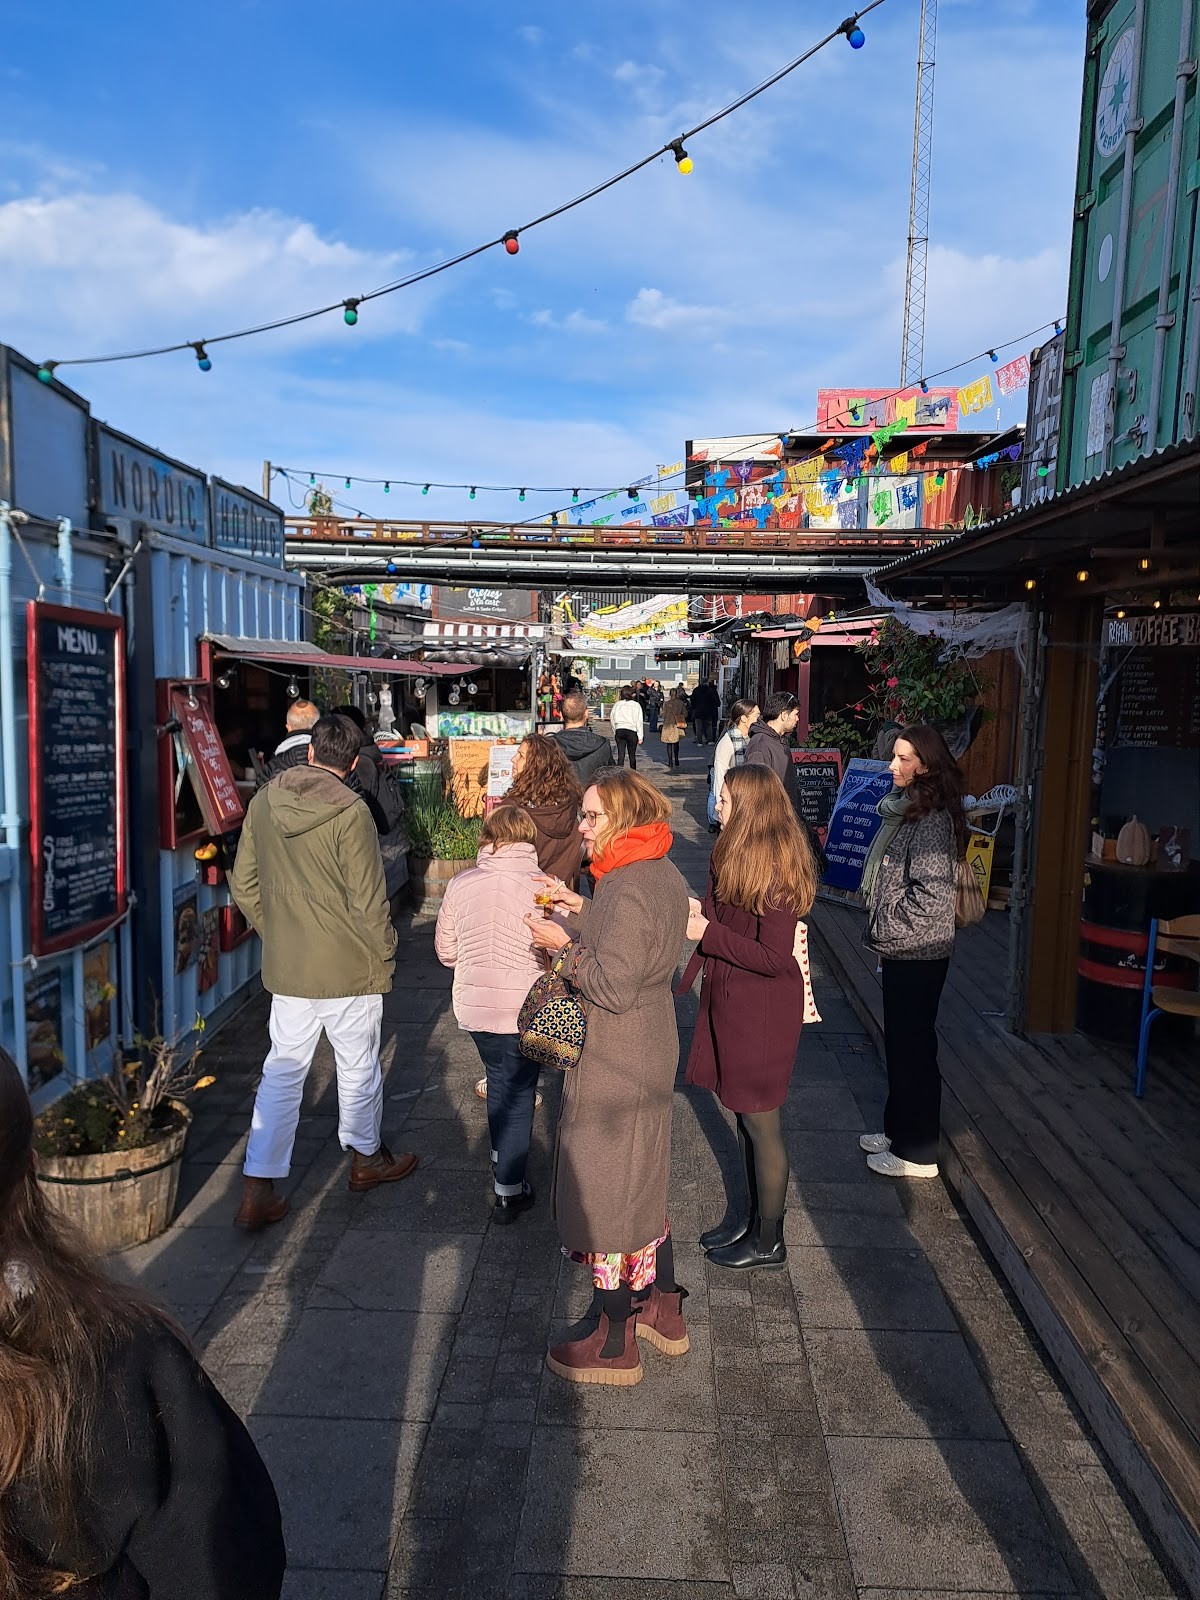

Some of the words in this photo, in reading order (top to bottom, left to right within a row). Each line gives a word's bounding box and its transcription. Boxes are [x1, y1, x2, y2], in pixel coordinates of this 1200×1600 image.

[112, 449, 196, 532] NORDIC
[1133, 615, 1178, 644] COFFEE
[797, 768, 834, 776] MEXICAN
[873, 778, 891, 788] SHOP
